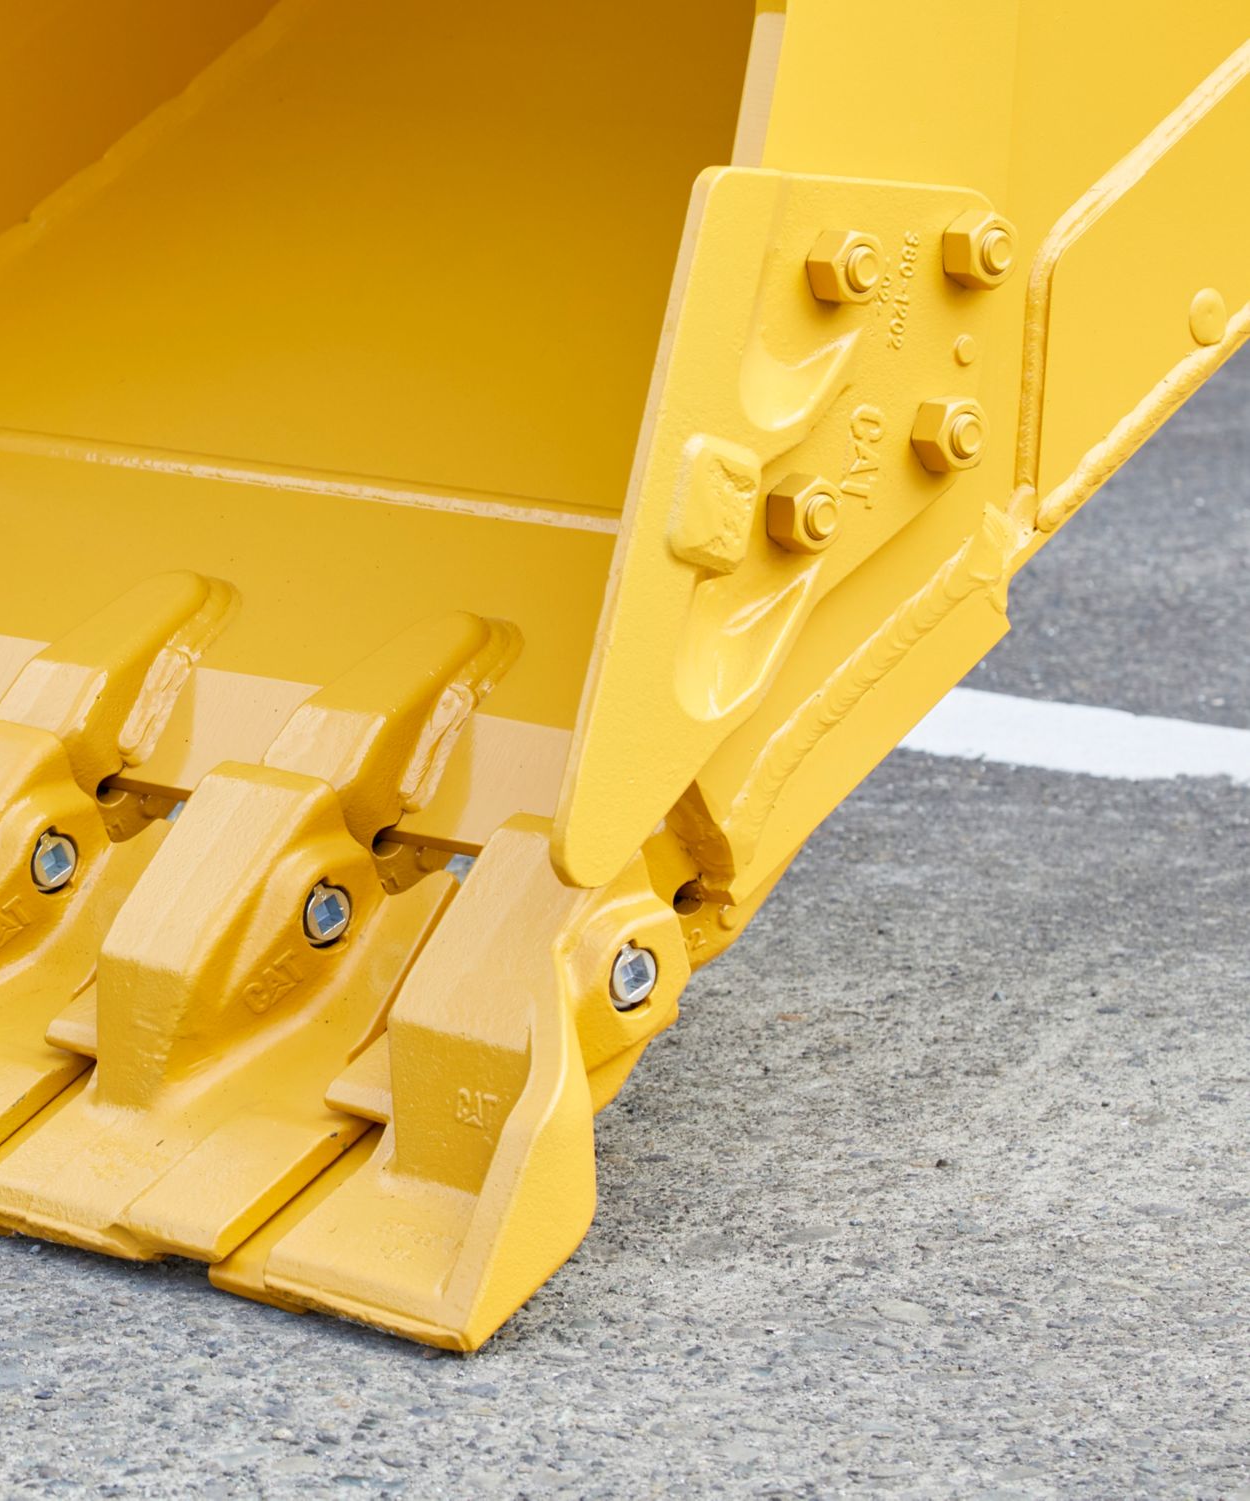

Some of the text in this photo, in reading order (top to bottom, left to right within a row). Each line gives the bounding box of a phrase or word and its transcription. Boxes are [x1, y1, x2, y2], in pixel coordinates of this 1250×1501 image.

[840, 403, 886, 511] CAT
[242, 949, 304, 1015] CAT
[455, 1087, 501, 1130] CAT
